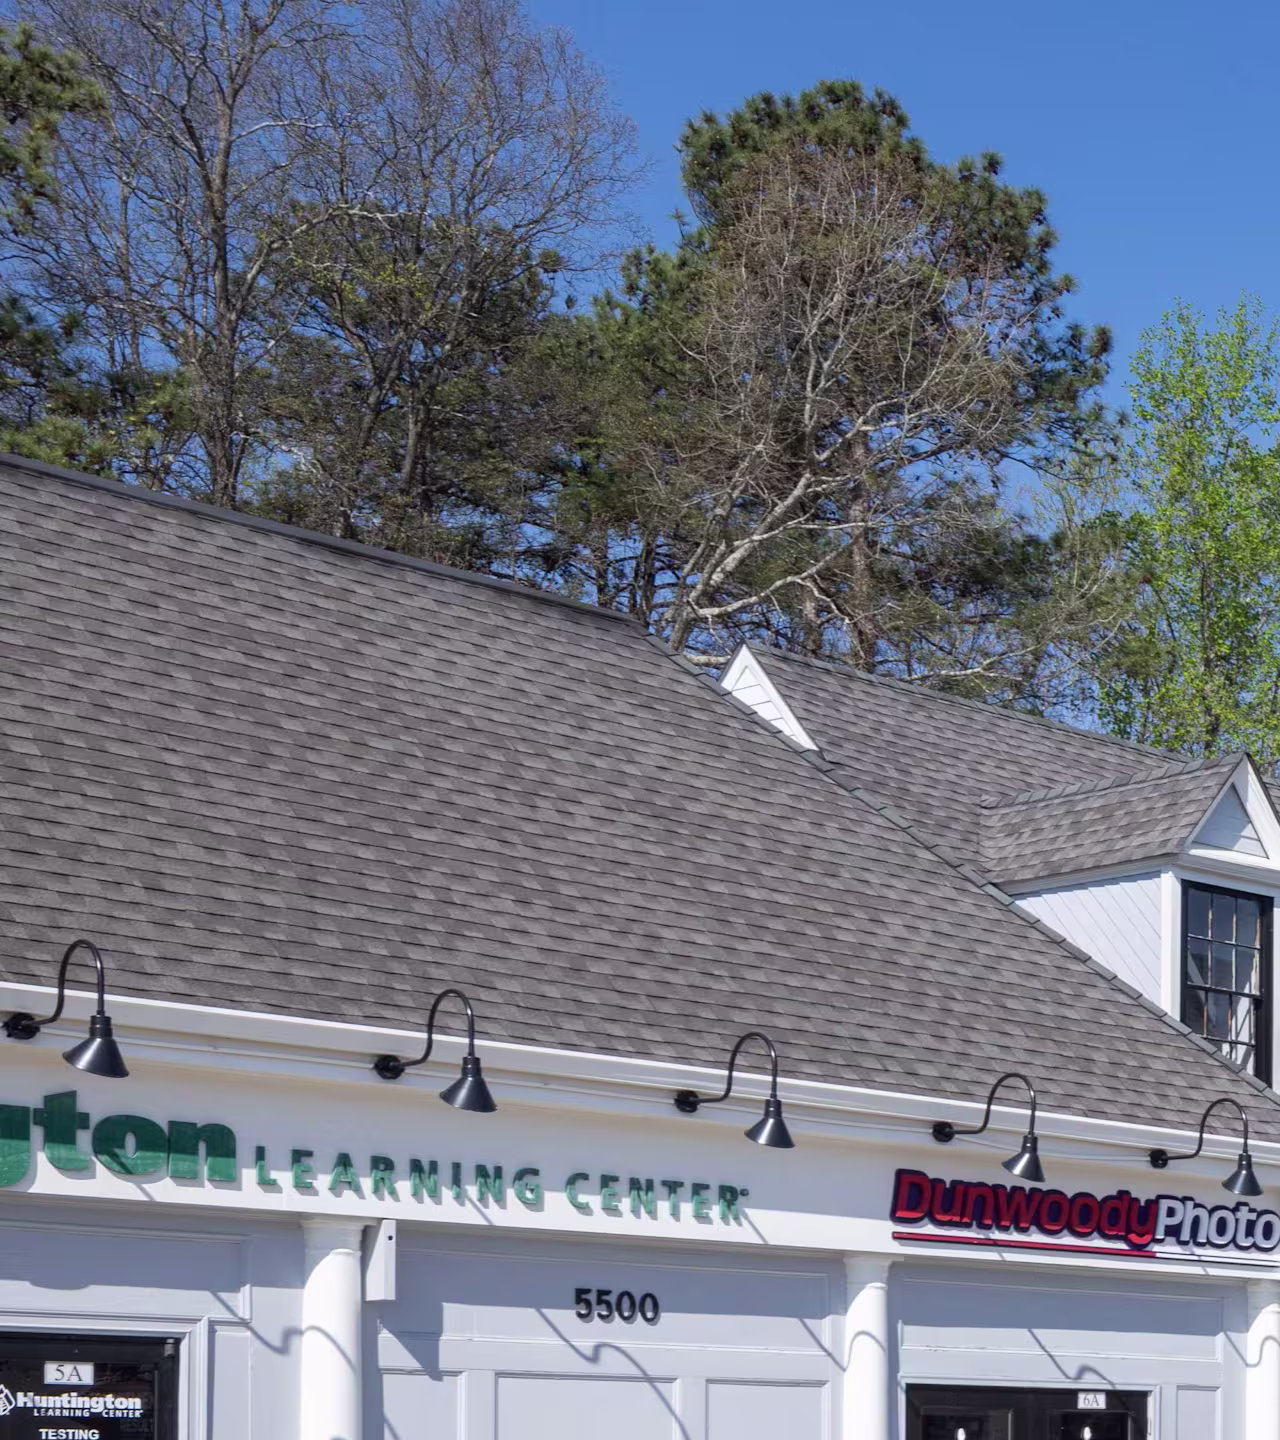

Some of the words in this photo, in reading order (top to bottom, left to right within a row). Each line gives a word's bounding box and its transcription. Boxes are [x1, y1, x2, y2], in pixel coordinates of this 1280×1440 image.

[254, 1145, 541, 1205] LEARNING
[573, 1287, 660, 1323] 5500
[54, 1364, 84, 1382] 5A
[16, 1391, 142, 1412] Huntington
[1083, 1392, 1100, 1407] 6A
[33, 1408, 91, 1417] LEARNING
[101, 1409, 142, 1418] CENTER
[38, 1428, 101, 1440] TESTING
